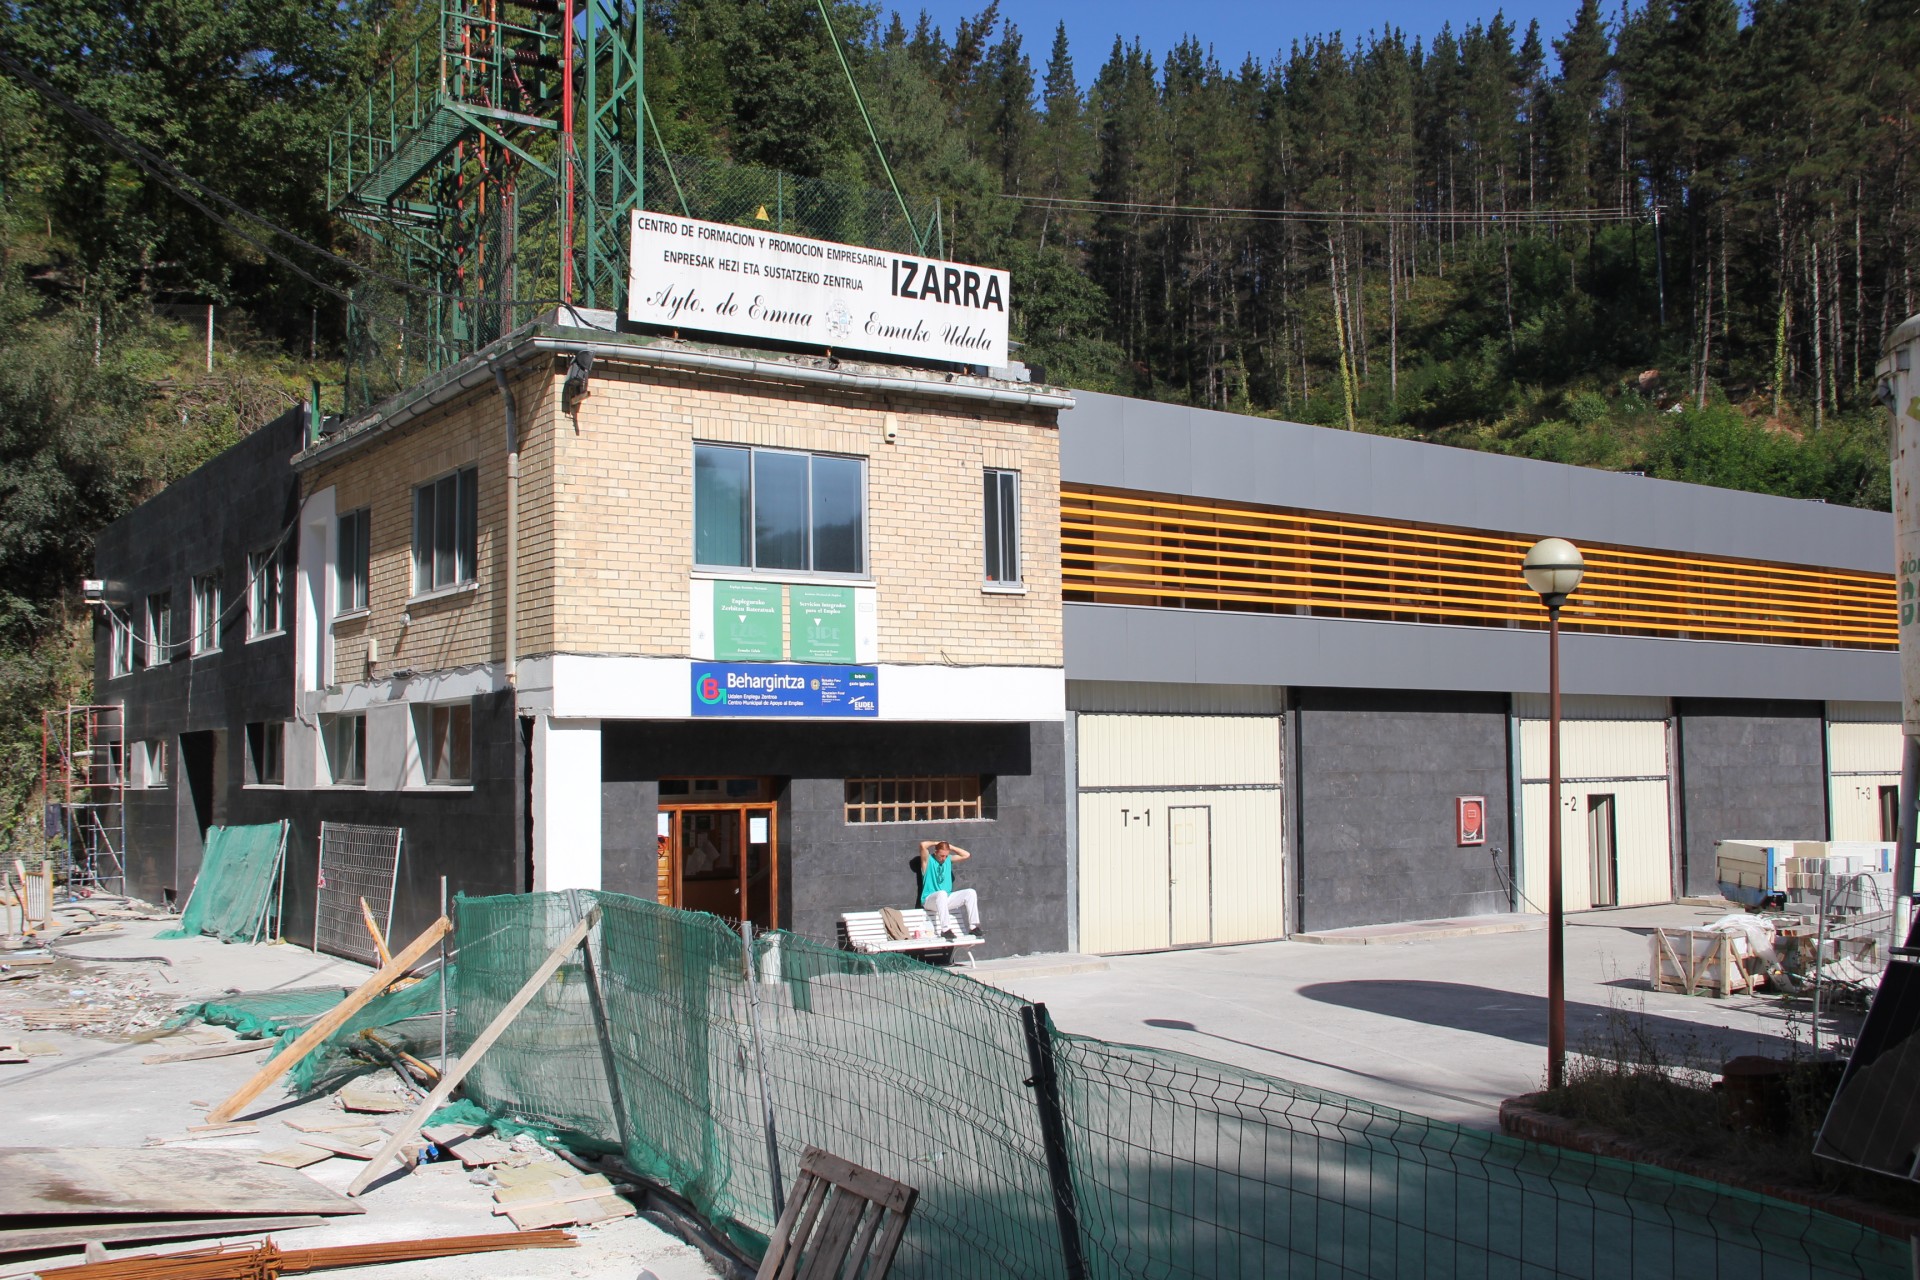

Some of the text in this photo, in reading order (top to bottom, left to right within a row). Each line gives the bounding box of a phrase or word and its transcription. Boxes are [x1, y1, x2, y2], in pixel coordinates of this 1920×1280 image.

[638, 217, 887, 269] CENTRO DE FORMACION Y PROMOCION EMPRESARIAL
[664, 250, 864, 291] ENPRESAK HEZI ETA SUSTATZEKO ZENTRUA
[891, 259, 1004, 312] IZARRA
[716, 292, 739, 317] de
[748, 294, 813, 327] Ermua
[864, 311, 993, 351] Ermuko Udala
[727, 673, 805, 692] Behargintza
[1855, 786, 1871, 800] T-3
[1121, 808, 1151, 827] T-1
